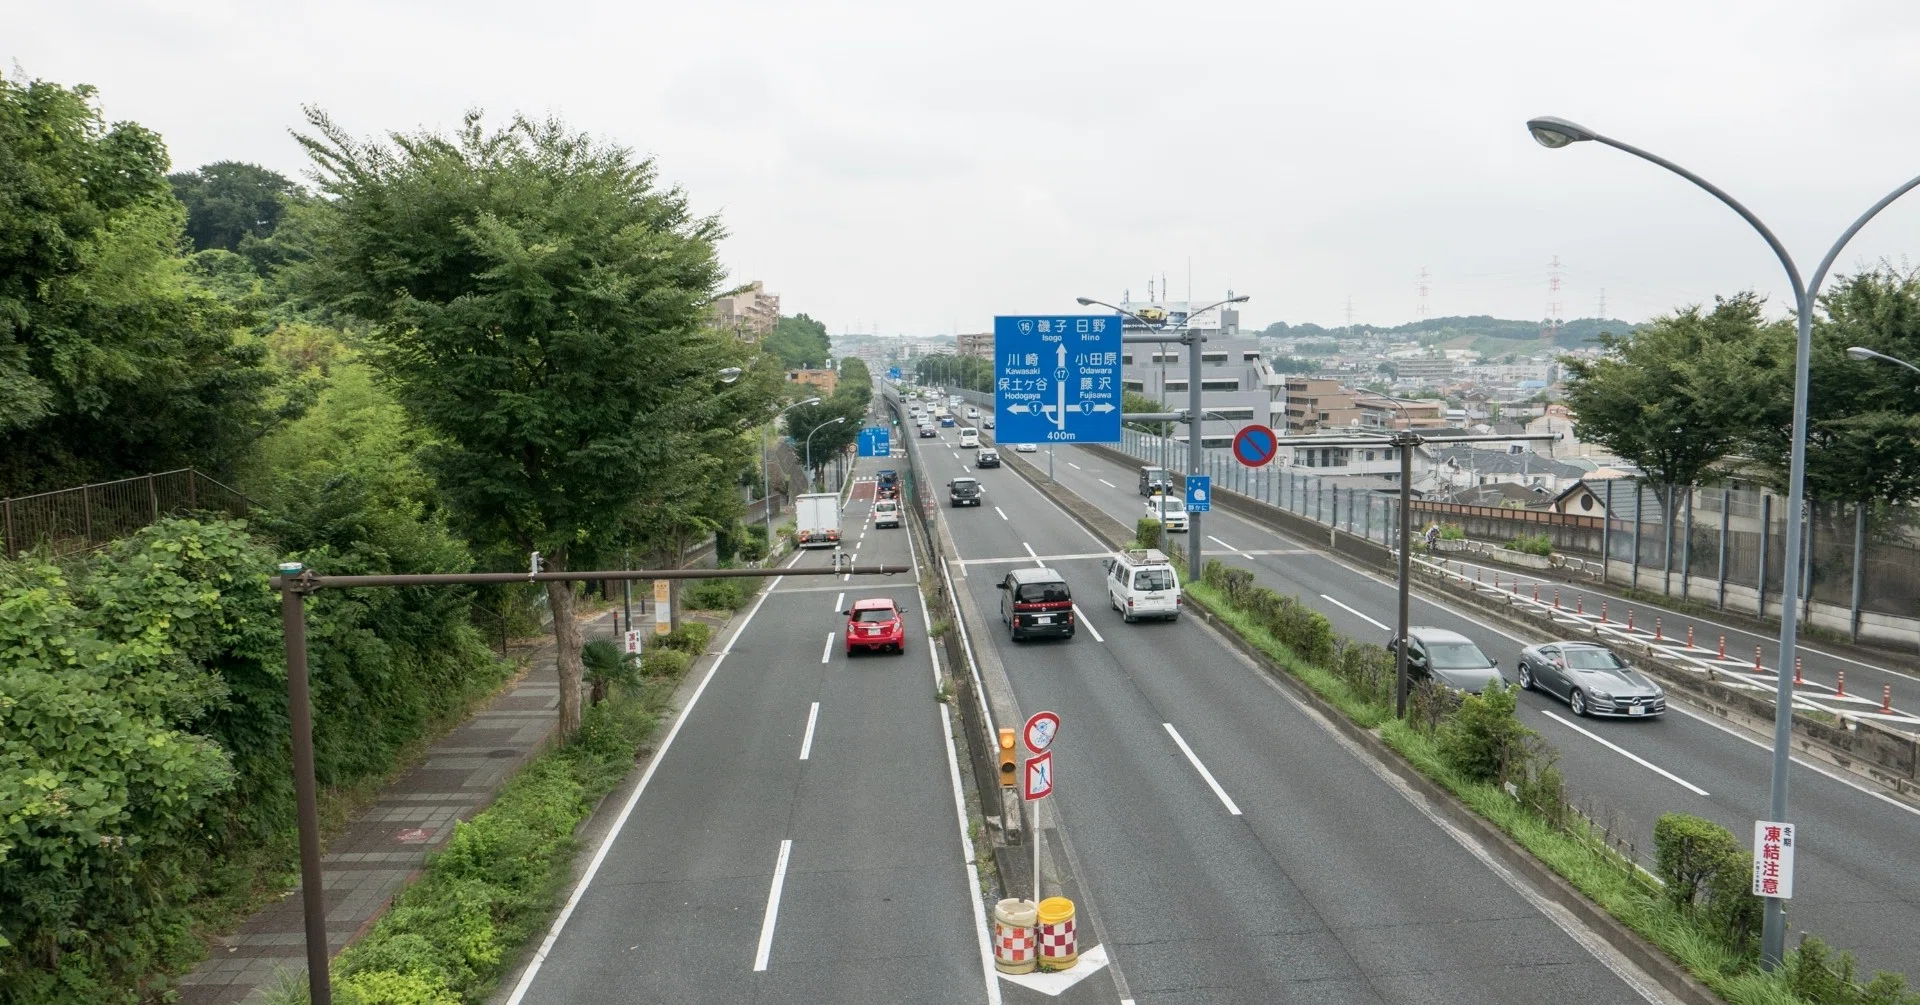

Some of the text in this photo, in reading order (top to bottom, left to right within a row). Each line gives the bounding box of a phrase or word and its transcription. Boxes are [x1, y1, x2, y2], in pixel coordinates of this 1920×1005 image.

[1020, 322, 1030, 331] 16
[1037, 319, 1068, 333] 磯子
[1076, 319, 1106, 333] 日野
[1041, 334, 1062, 342] Isogo
[1007, 353, 1039, 367] 川崎
[1075, 352, 1117, 366] 小田原
[1005, 367, 1040, 375] Kawasaki
[1056, 370, 1066, 379] 17
[1079, 367, 1112, 375] Odawara
[1080, 377, 1112, 391] 藤沢
[1005, 392, 1041, 401] Hodogaya
[1079, 391, 1112, 400] Fujisawa
[1047, 431, 1076, 440] 400m
[1762, 826, 1782, 894] 凍結注意
